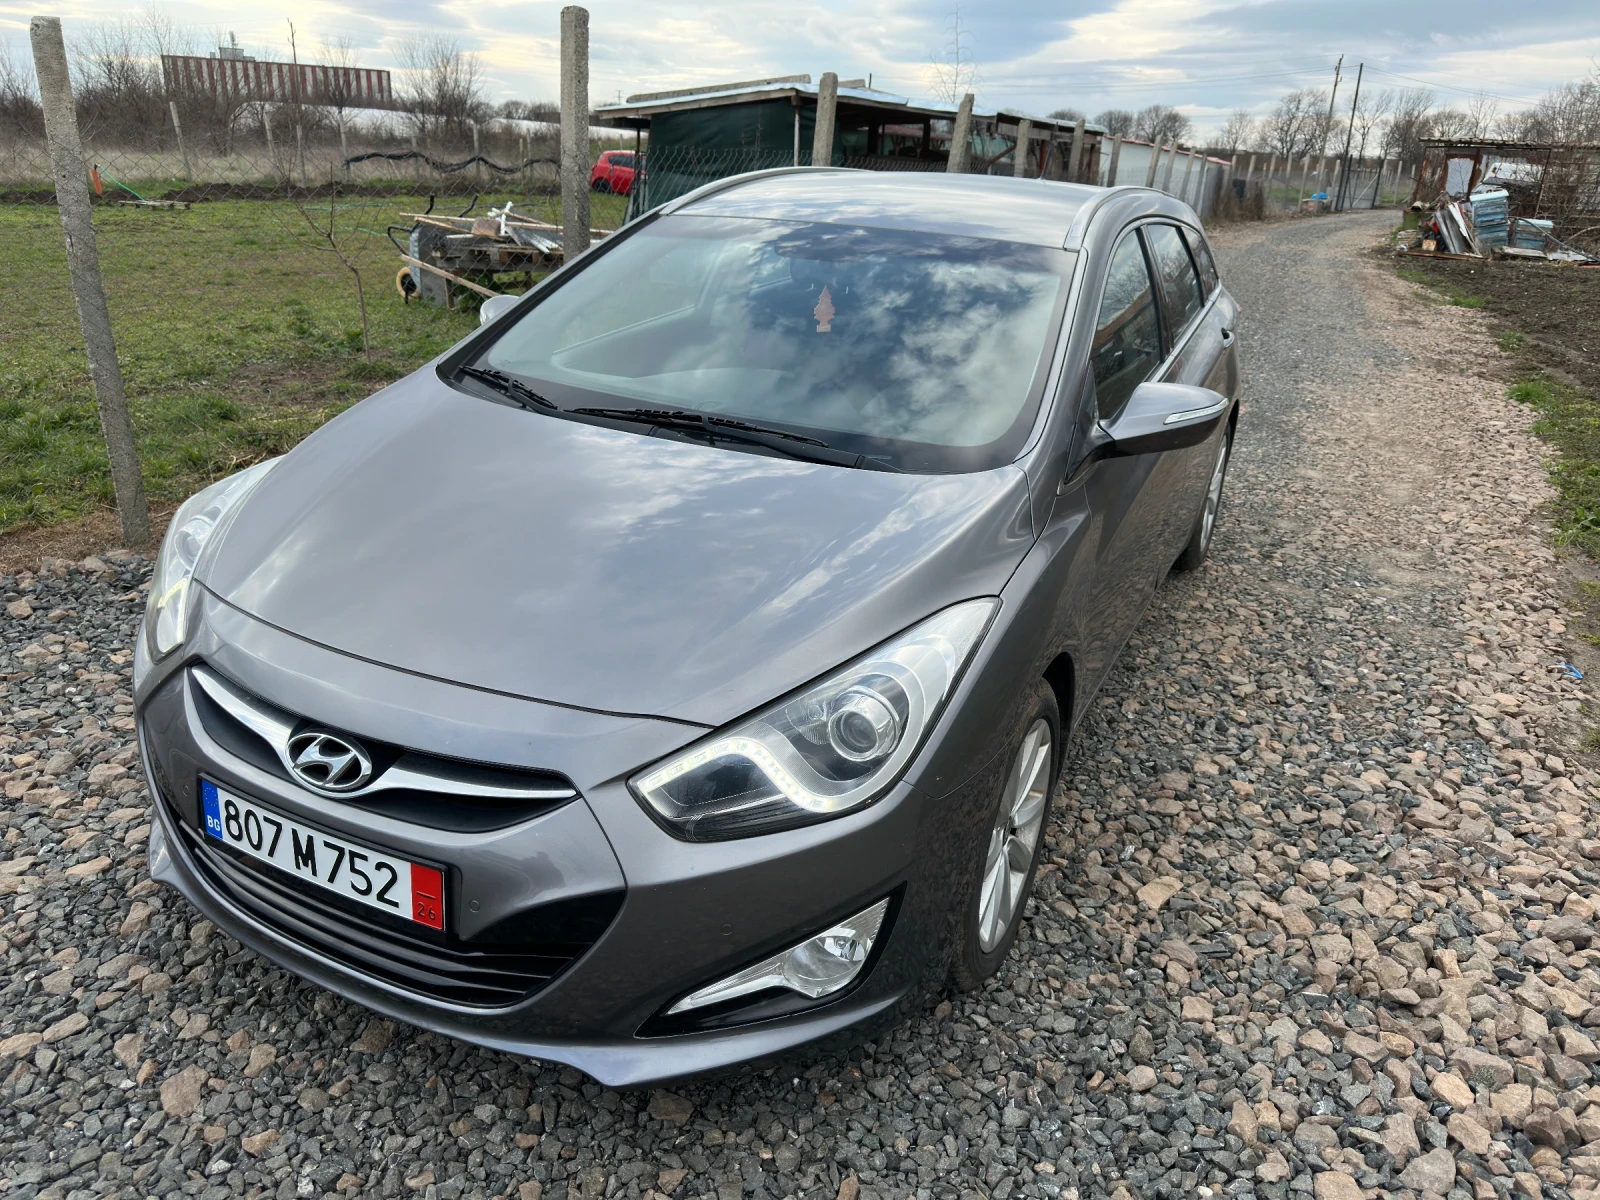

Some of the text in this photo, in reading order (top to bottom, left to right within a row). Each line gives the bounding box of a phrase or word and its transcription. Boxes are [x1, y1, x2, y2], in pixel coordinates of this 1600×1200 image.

[207, 815, 221, 831] BG
[224, 799, 283, 858] 807
[417, 902, 436, 920] 26
